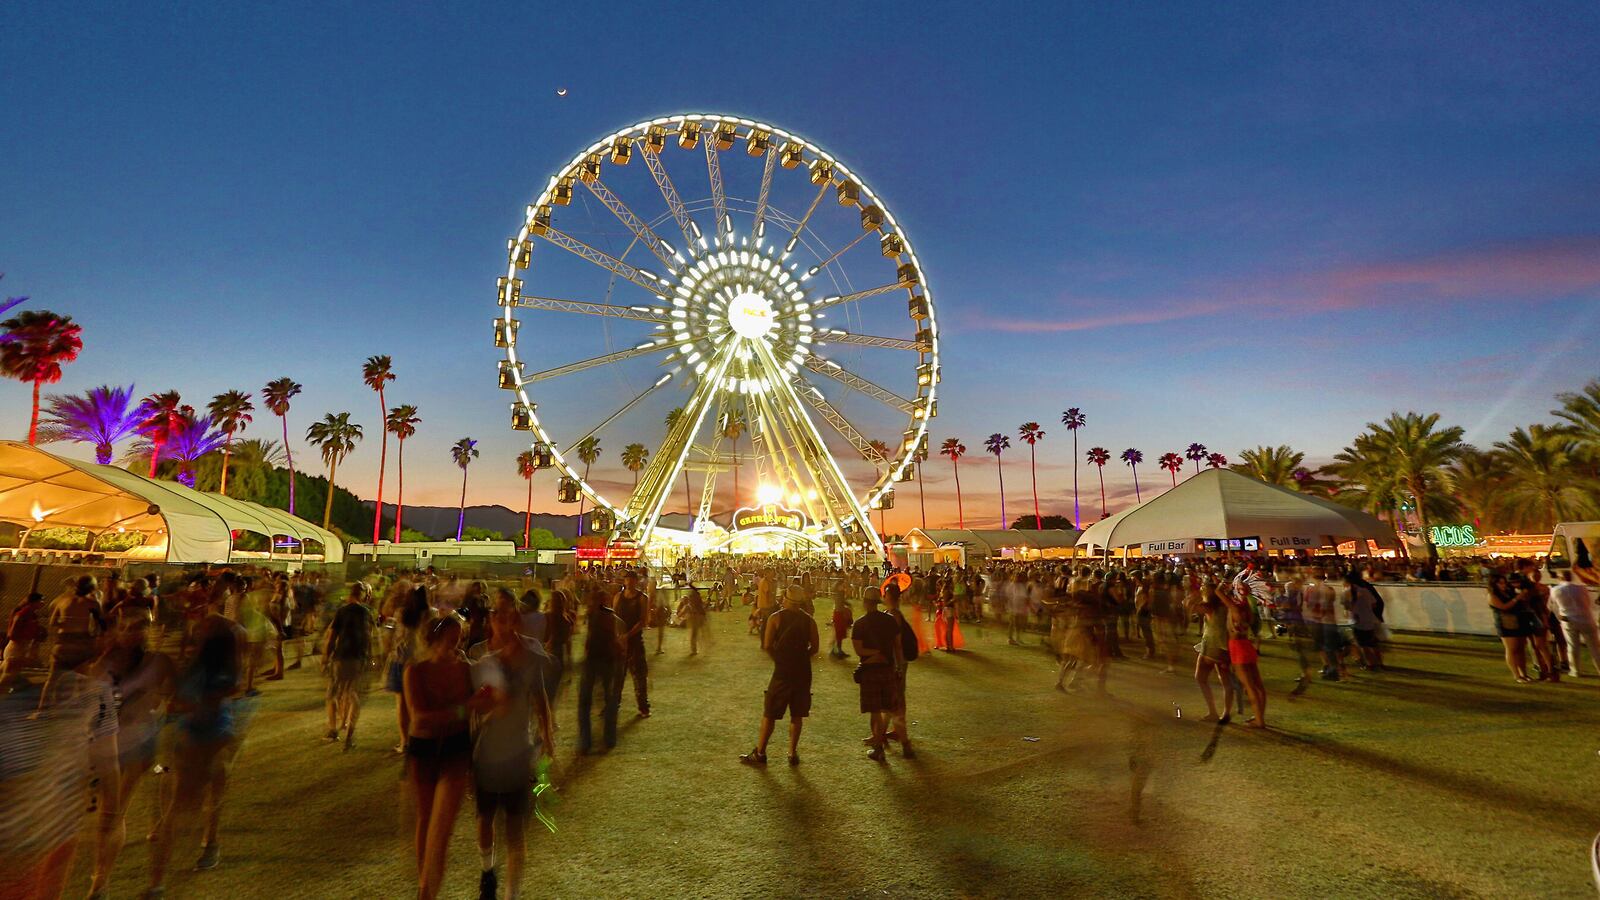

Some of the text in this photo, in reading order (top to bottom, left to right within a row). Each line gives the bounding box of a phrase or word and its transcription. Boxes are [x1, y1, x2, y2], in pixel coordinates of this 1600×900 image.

[1431, 525, 1475, 545] ACOS
[1148, 541, 1185, 551] Full Bar
[1270, 536, 1311, 546] Full Bar
